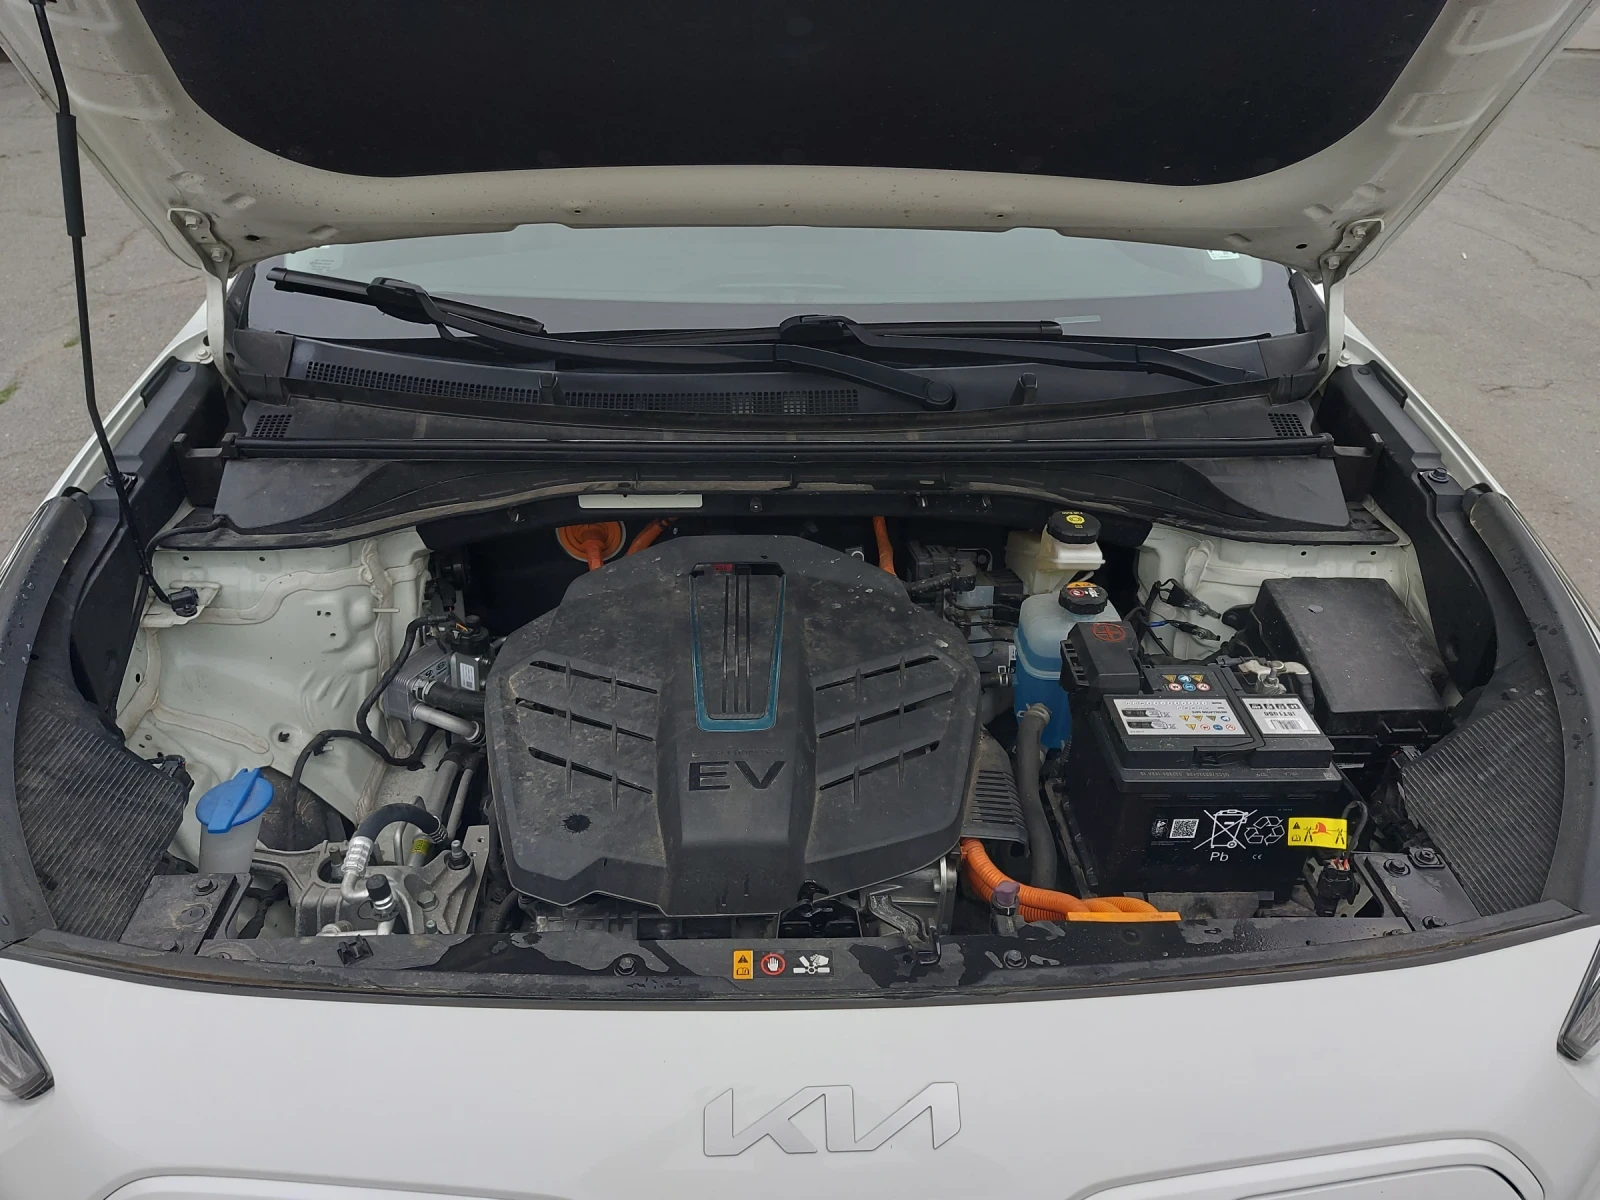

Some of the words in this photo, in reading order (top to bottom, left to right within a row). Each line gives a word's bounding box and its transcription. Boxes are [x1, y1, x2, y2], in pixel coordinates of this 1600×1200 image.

[689, 761, 787, 791] EV
[1209, 851, 1229, 862] Pb
[703, 1081, 962, 1157] KIA
